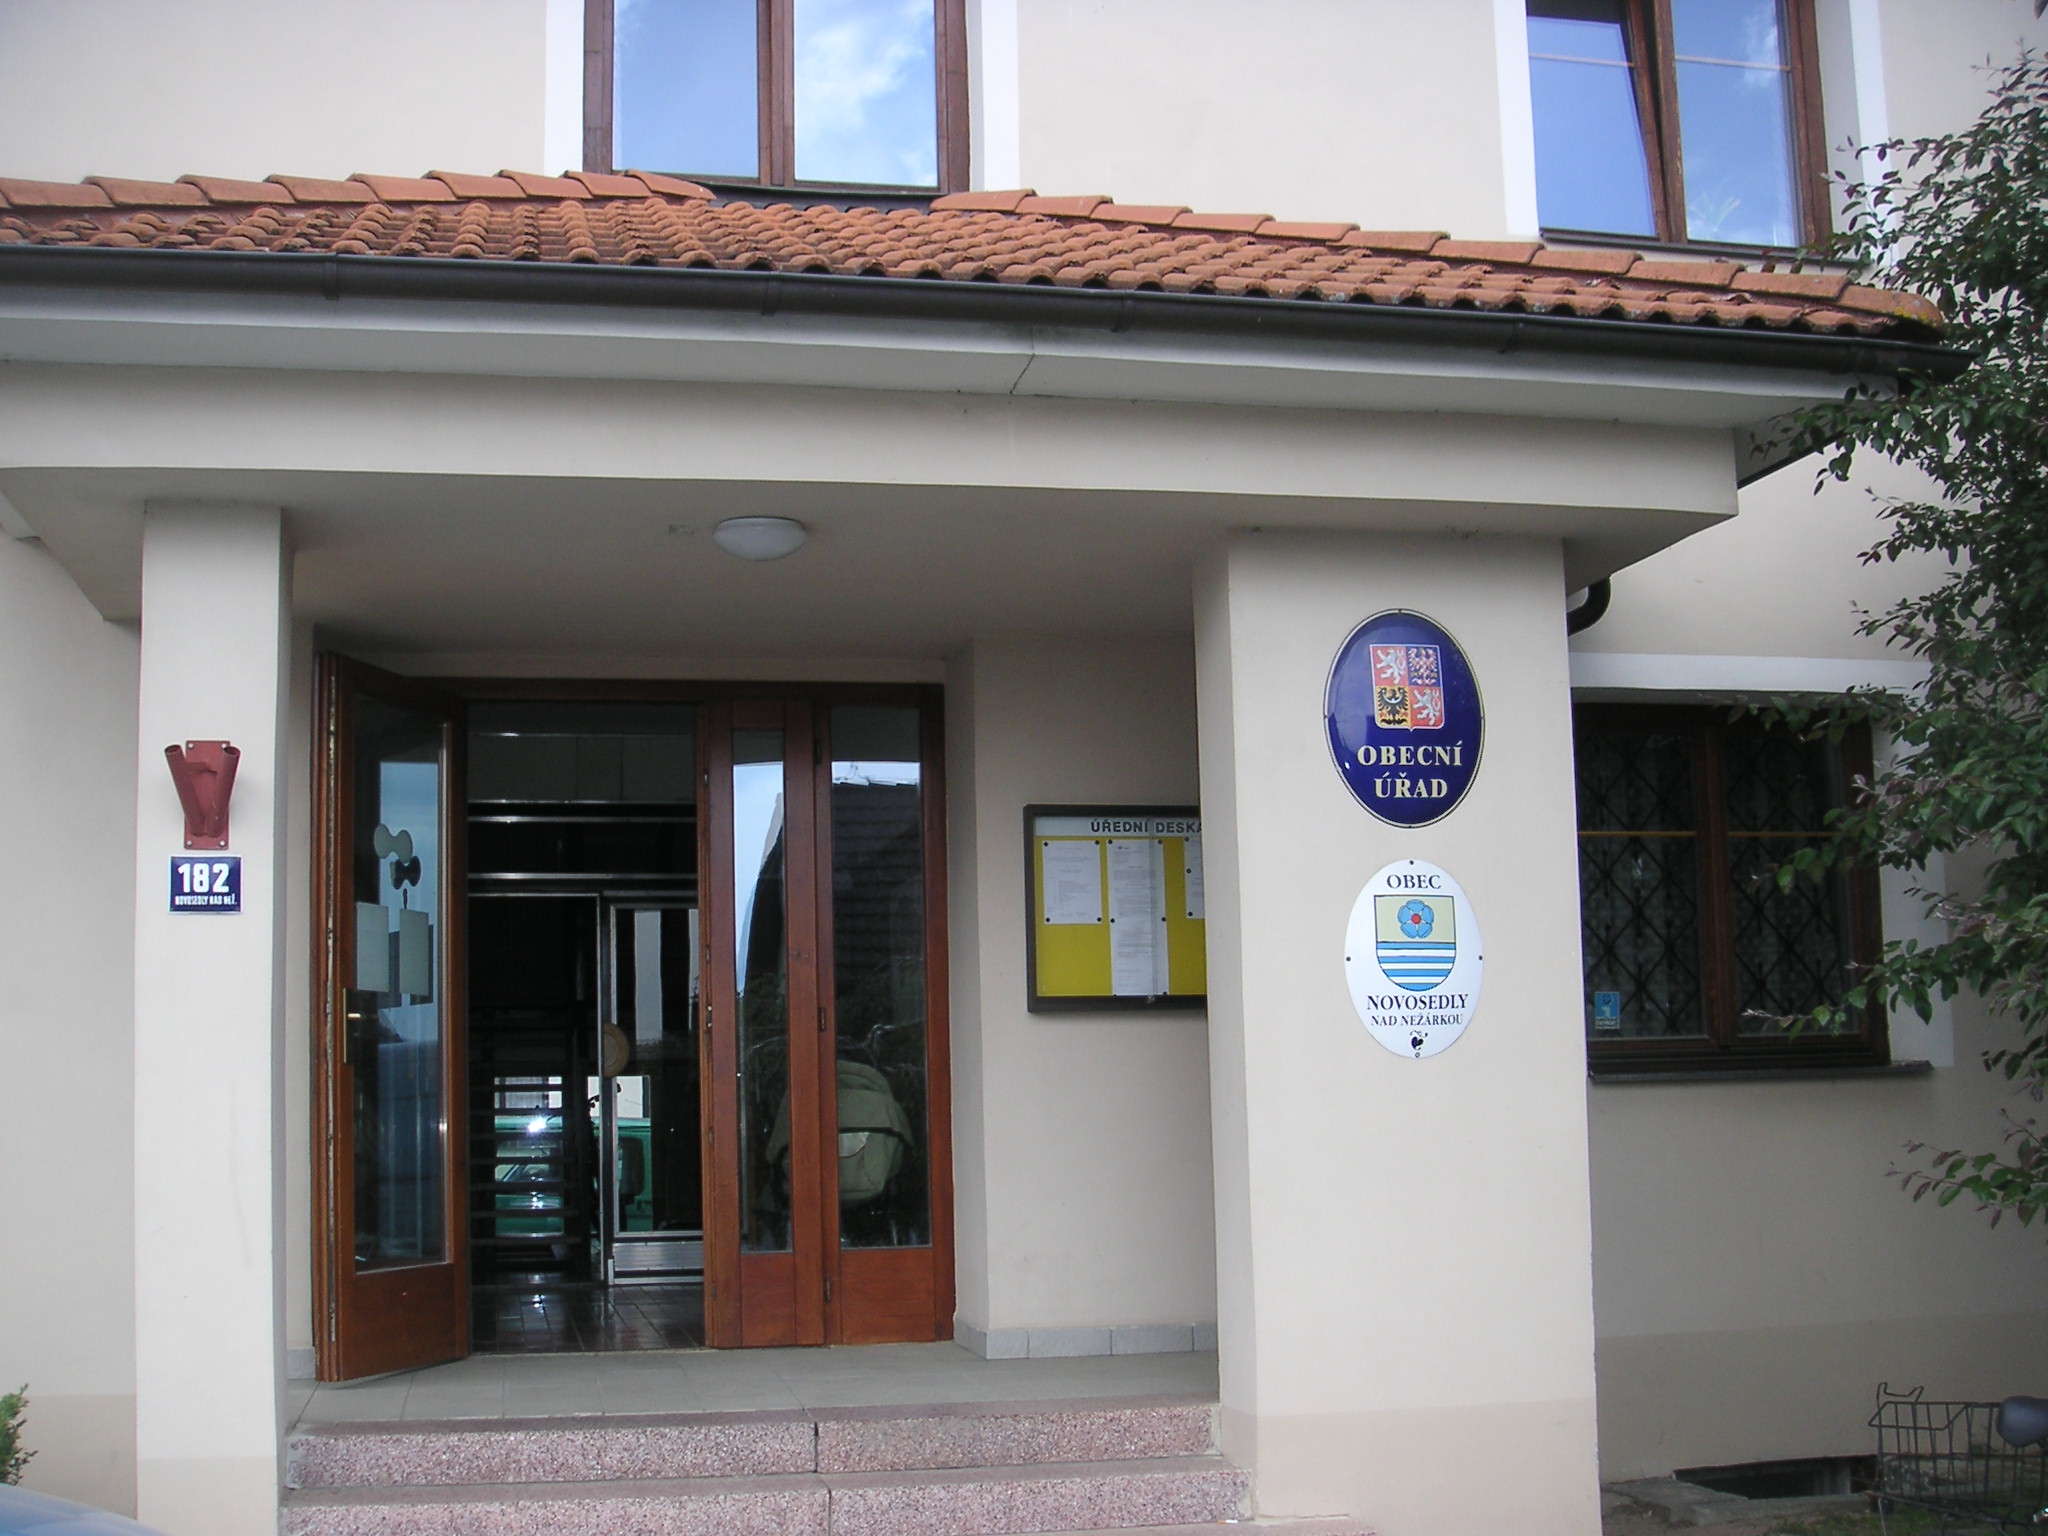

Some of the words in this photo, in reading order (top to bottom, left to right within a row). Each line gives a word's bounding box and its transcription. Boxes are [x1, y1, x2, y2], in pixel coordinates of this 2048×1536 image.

[1357, 741, 1462, 766] OBECNÍ
[1374, 771, 1448, 798] ÚŘAD
[1091, 818, 1148, 833] ÚŘEDNÍ
[177, 862, 230, 893] 182
[1386, 874, 1442, 889] OBEC
[209, 895, 222, 905] NAD
[1367, 994, 1469, 1010] NOVOSEDLY
[1371, 1014, 1398, 1026] NAD
[1400, 1011, 1463, 1026] NEŽÁRKOU
